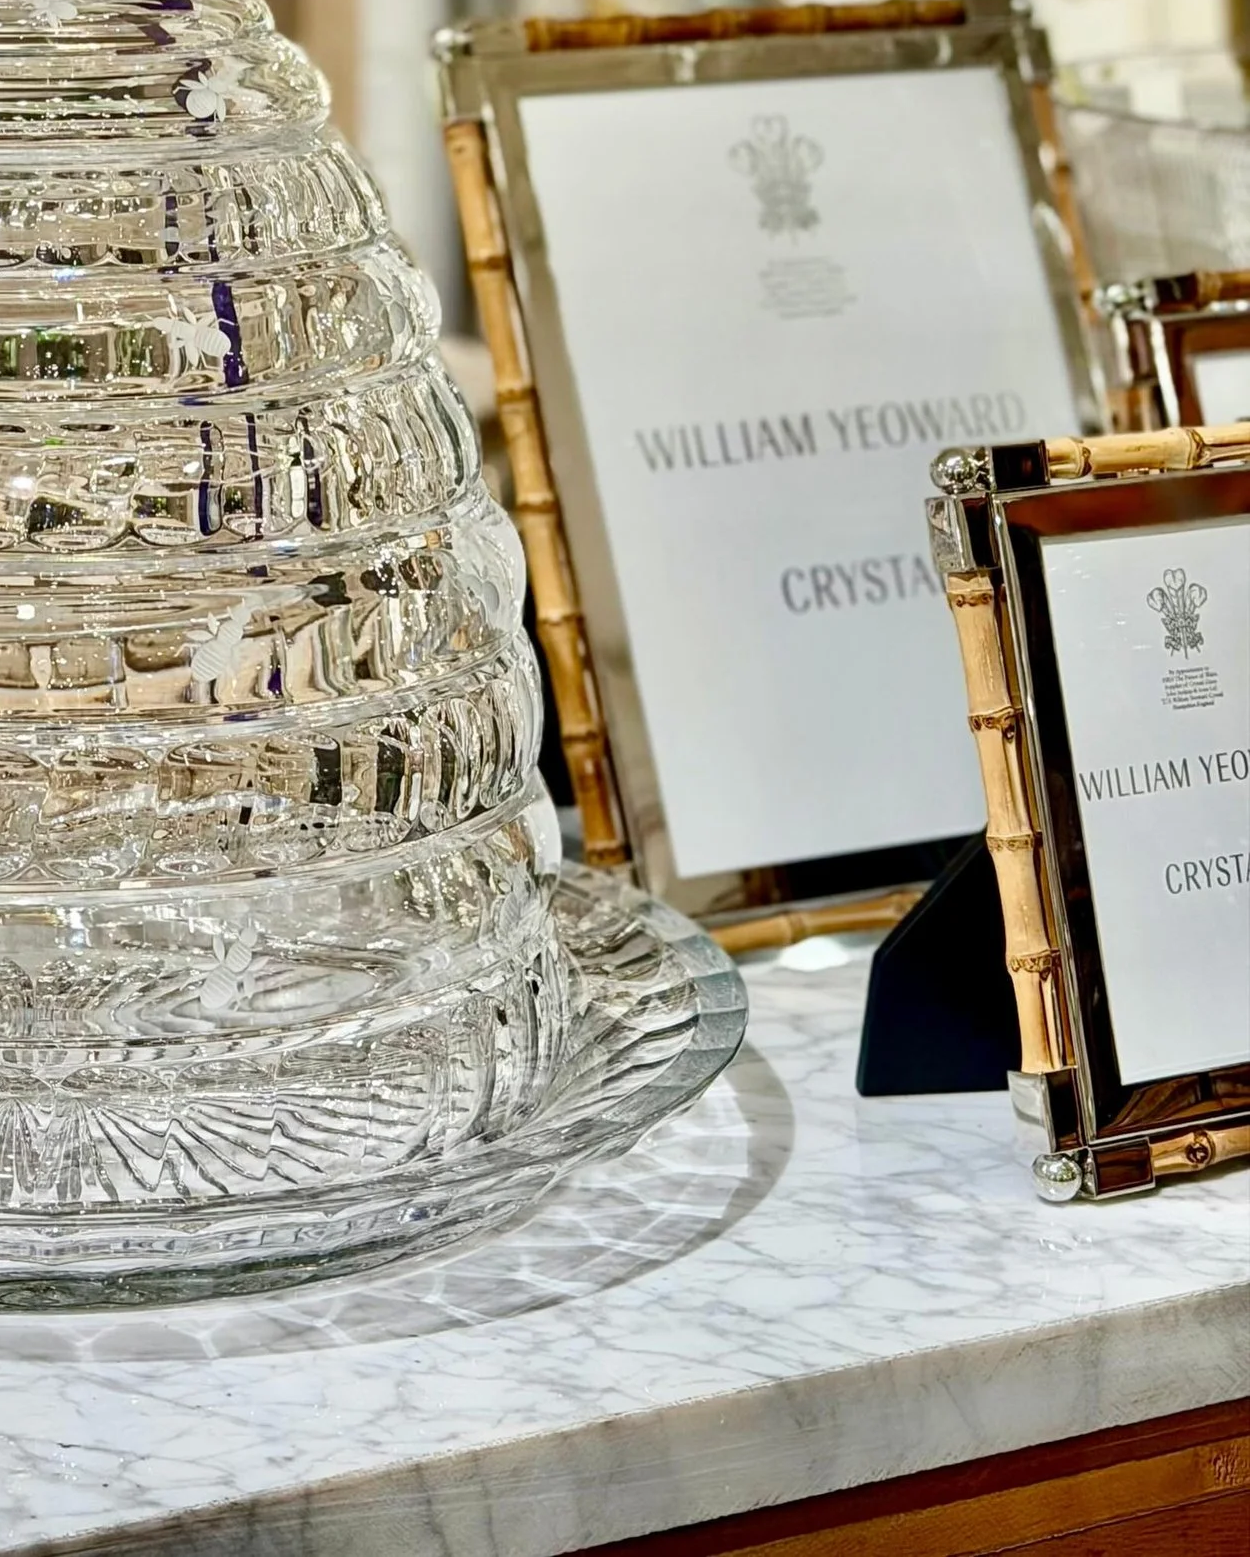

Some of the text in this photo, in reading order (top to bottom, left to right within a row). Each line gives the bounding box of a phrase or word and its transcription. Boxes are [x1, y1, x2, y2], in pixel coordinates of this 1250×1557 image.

[635, 390, 1027, 473] WILLIAM YEOWARD
[1078, 749, 1250, 802] WILLIAM YEO
